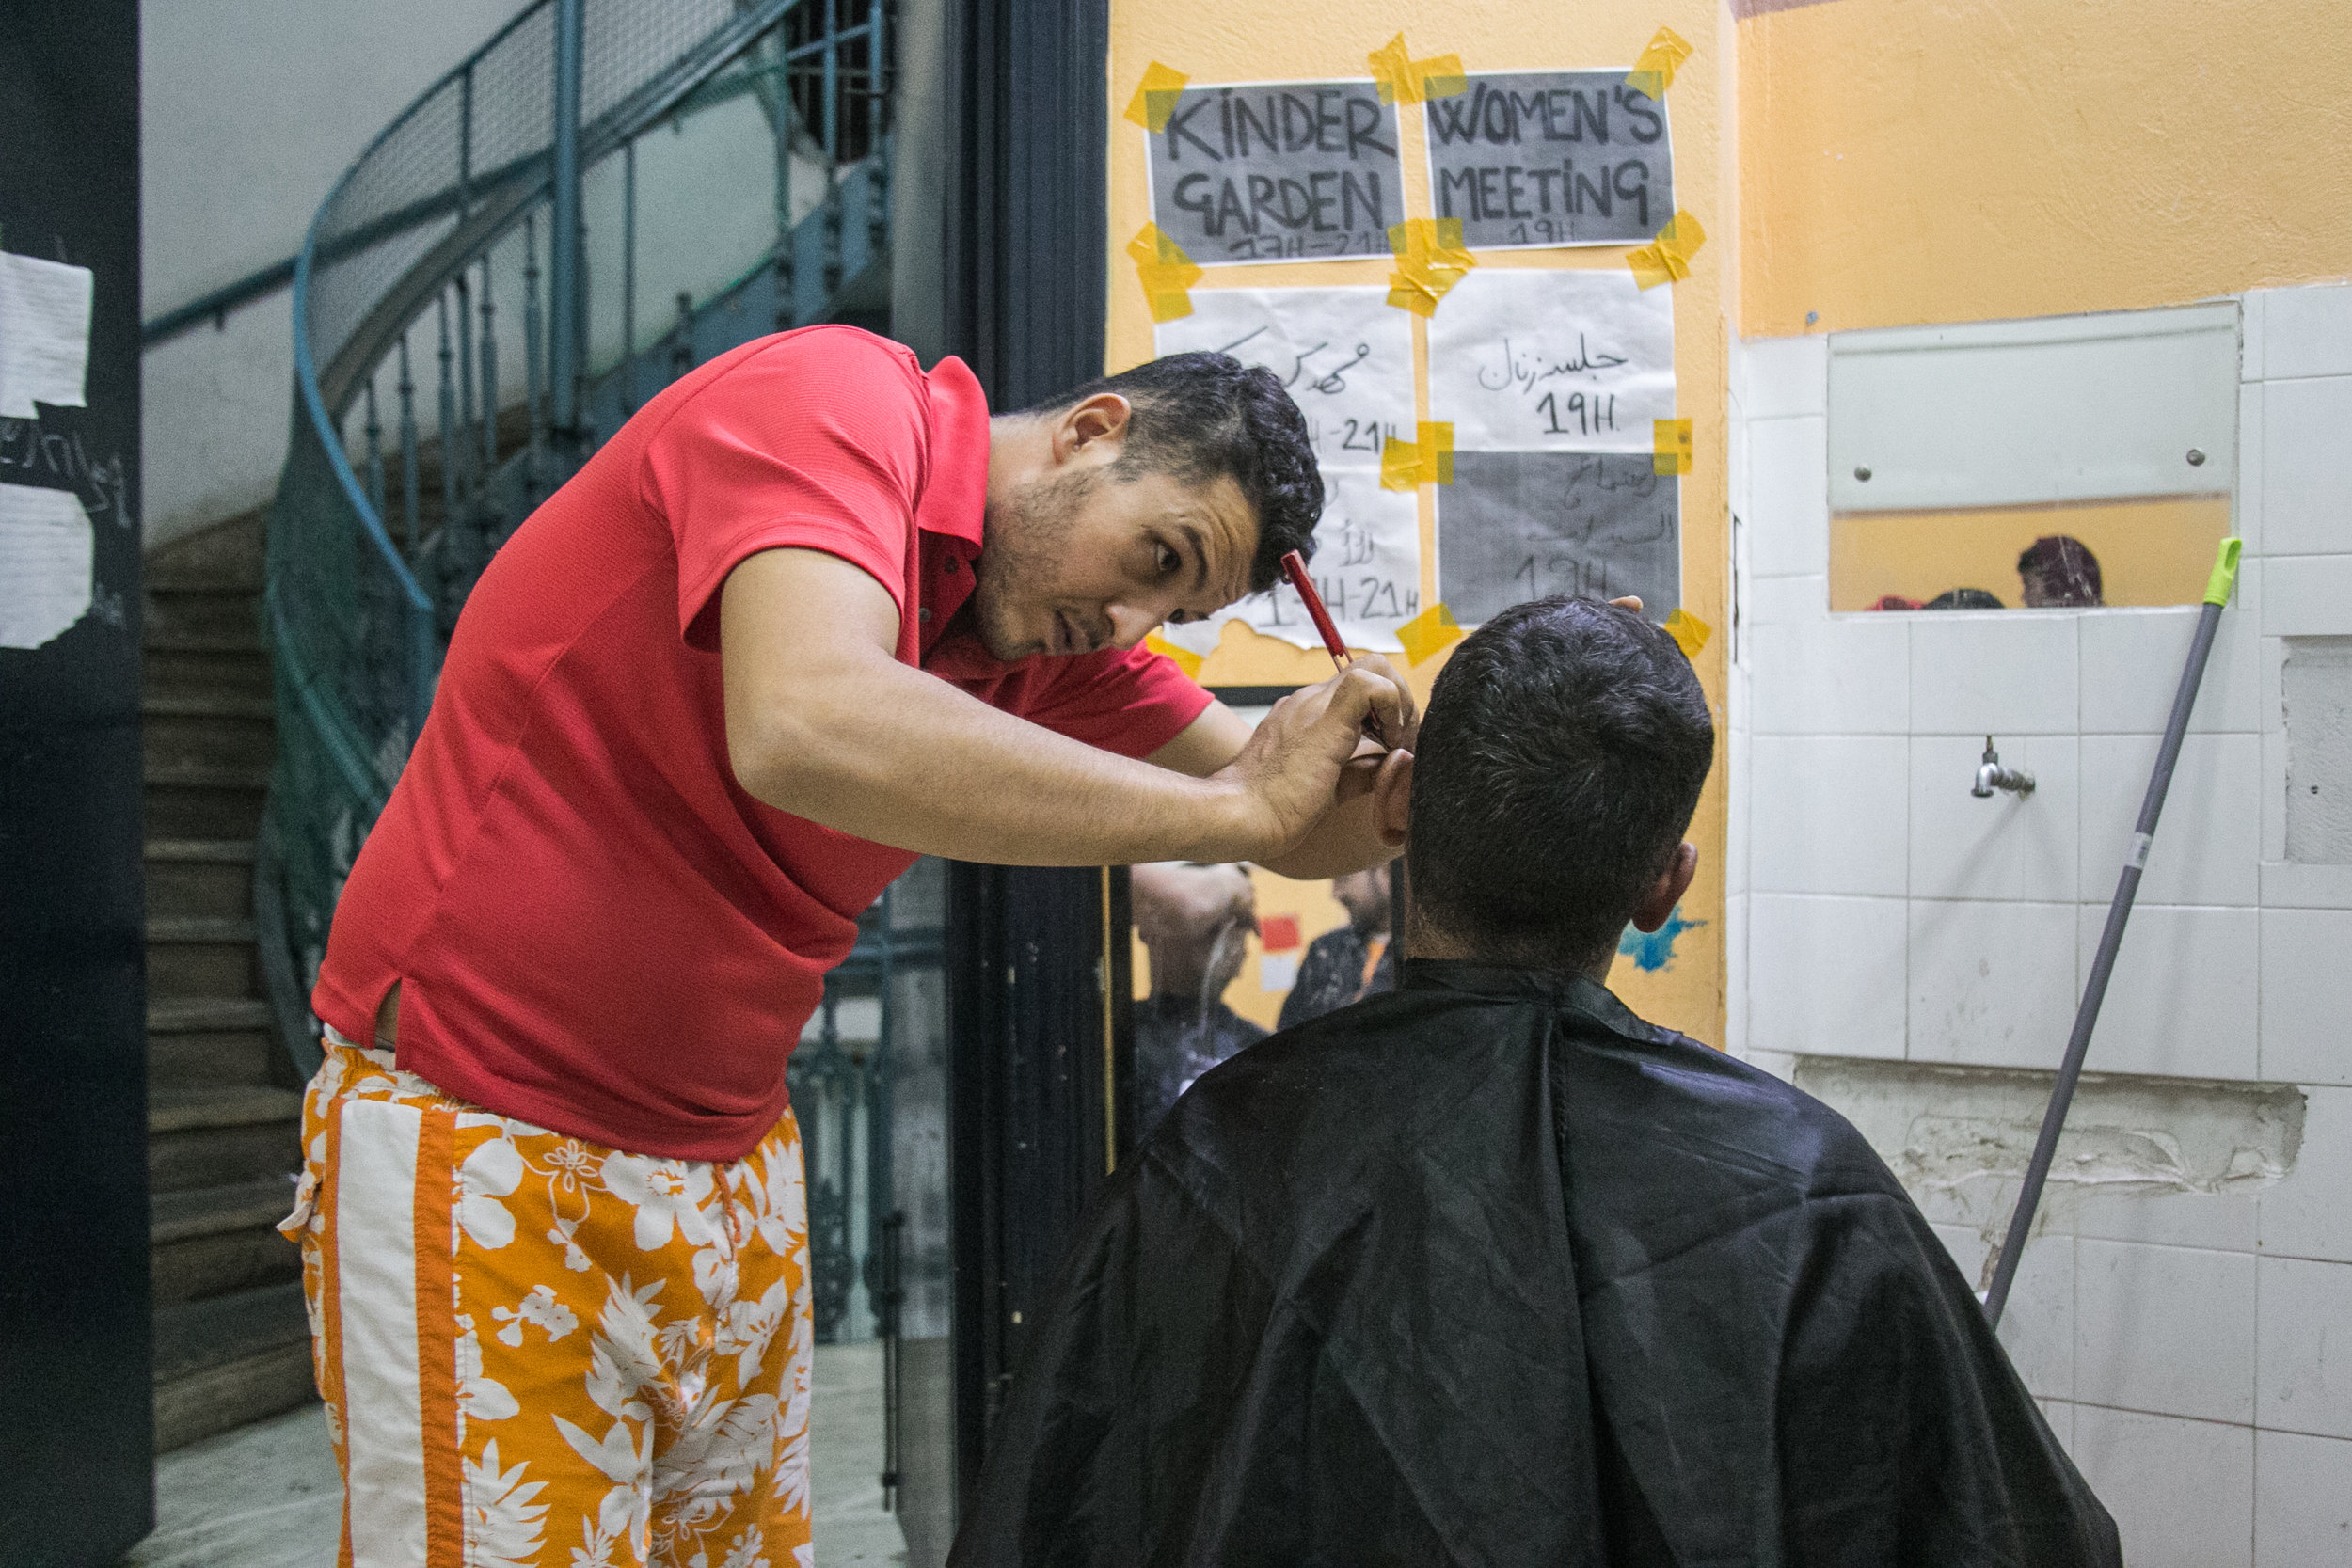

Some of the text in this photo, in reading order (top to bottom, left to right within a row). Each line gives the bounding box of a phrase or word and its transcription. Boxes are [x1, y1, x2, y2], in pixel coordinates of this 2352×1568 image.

[1166, 87, 1397, 162] KINDER
[1426, 81, 1662, 145] WOMEN'S
[1173, 170, 1384, 236] GARDEN
[1440, 158, 1649, 226] MEETING
[1509, 218, 1575, 244] 19H
